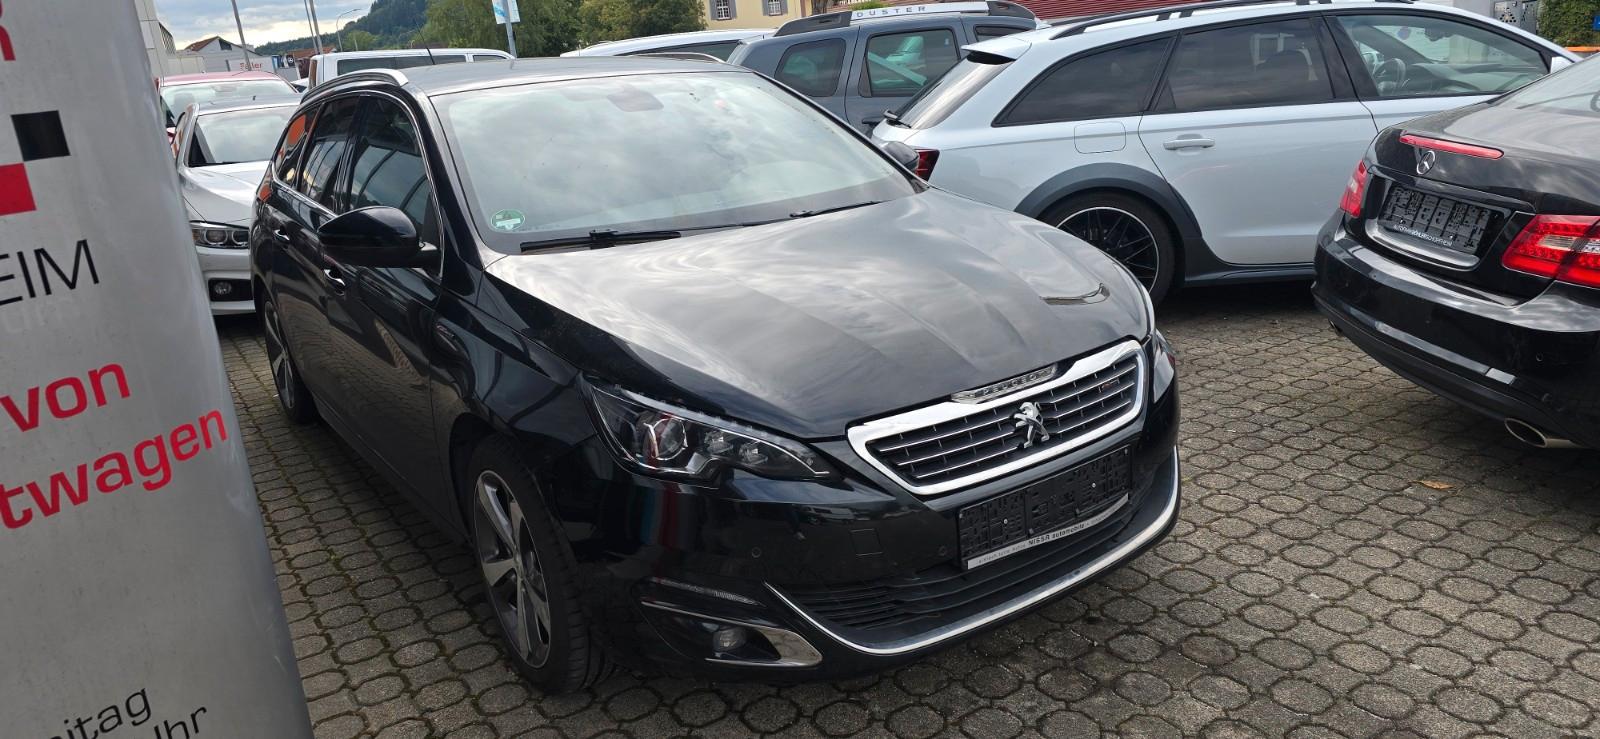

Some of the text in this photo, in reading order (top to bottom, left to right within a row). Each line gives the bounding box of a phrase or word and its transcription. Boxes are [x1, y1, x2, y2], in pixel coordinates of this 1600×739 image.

[856, 6, 926, 17] DUSTER
[0, 363, 130, 432] von
[982, 370, 1046, 395] PEUGEO
[0, 410, 228, 529] twagen
[50, 688, 151, 739] itag
